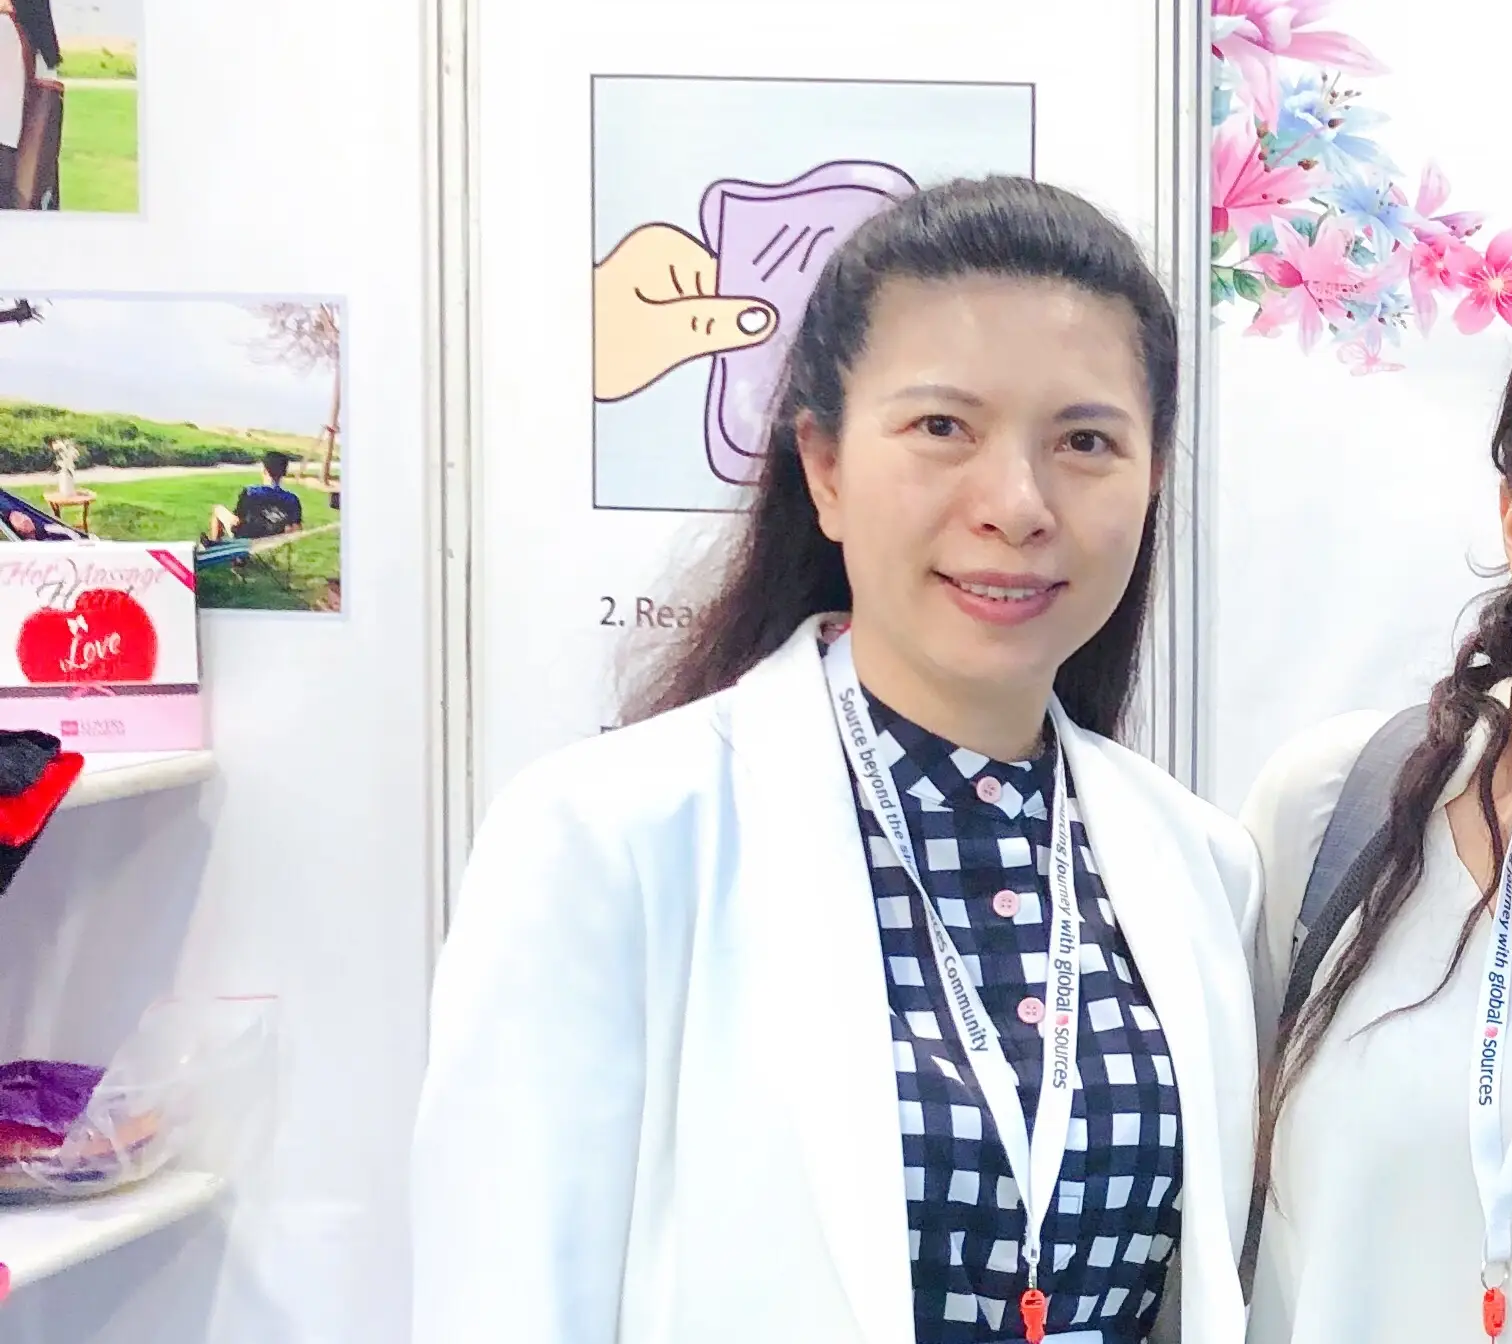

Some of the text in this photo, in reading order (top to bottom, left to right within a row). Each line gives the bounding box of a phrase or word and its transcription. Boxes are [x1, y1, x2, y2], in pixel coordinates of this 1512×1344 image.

[600, 596, 625, 627] 2.
[839, 687, 904, 841] Source beyond the
[1056, 856, 1072, 917] journey
[1059, 919, 1076, 954] with
[1493, 933, 1509, 968] with
[944, 956, 989, 1052] Community
[1054, 958, 1076, 1013] global
[1488, 971, 1507, 1025] global
[1052, 1026, 1070, 1091] sources
[1478, 1038, 1497, 1106] sources
